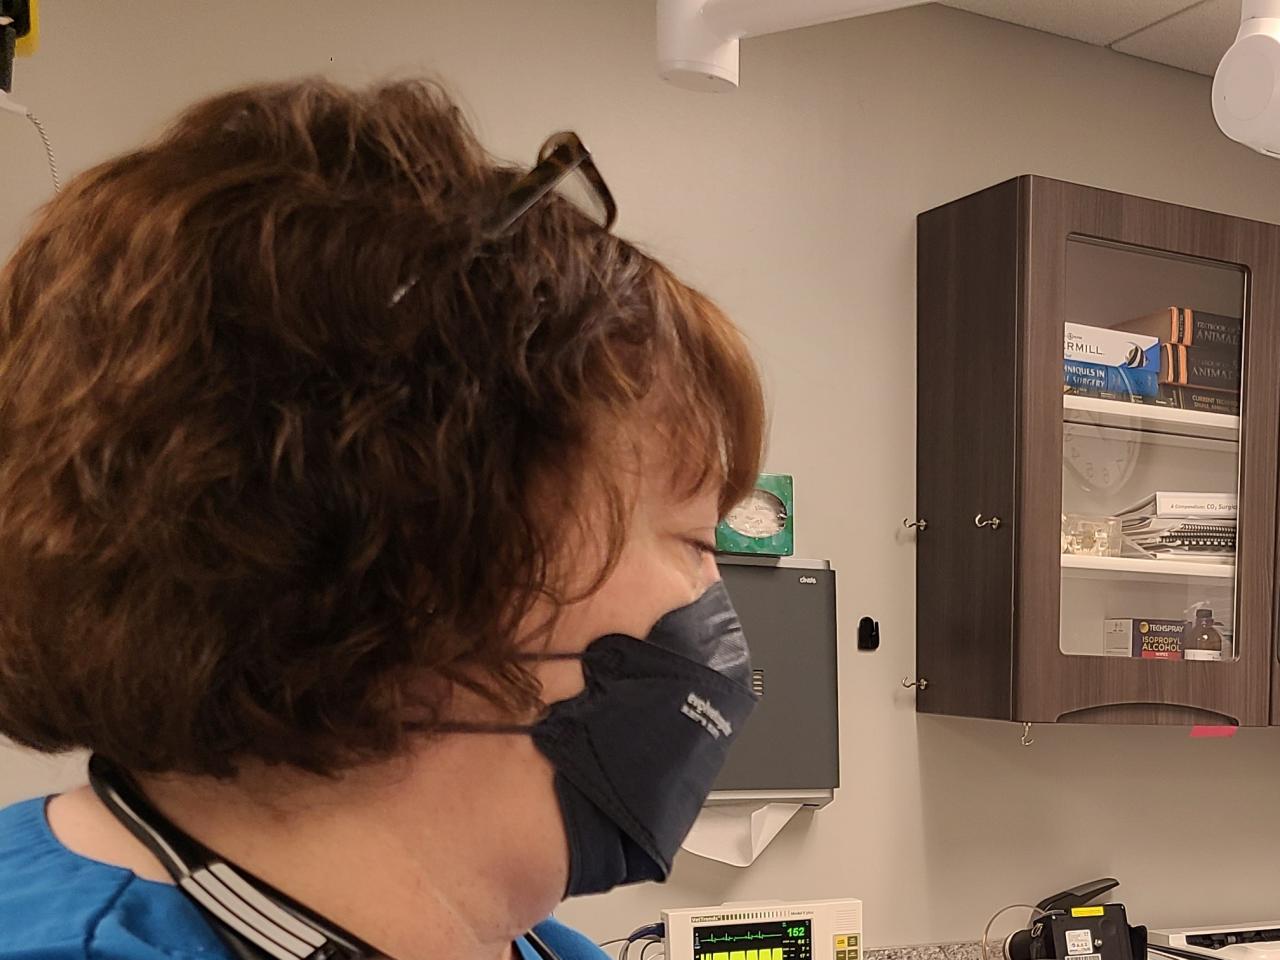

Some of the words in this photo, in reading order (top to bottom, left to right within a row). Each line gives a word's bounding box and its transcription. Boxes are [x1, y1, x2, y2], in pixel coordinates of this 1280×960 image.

[1064, 341, 1103, 356] RMILL
[1096, 370, 1105, 379] IN
[1149, 624, 1185, 633] TECHSPRAY
[1142, 636, 1182, 645] ISOPROPYL
[1142, 643, 1182, 652] ALCOHOL
[787, 927, 805, 937] 152
